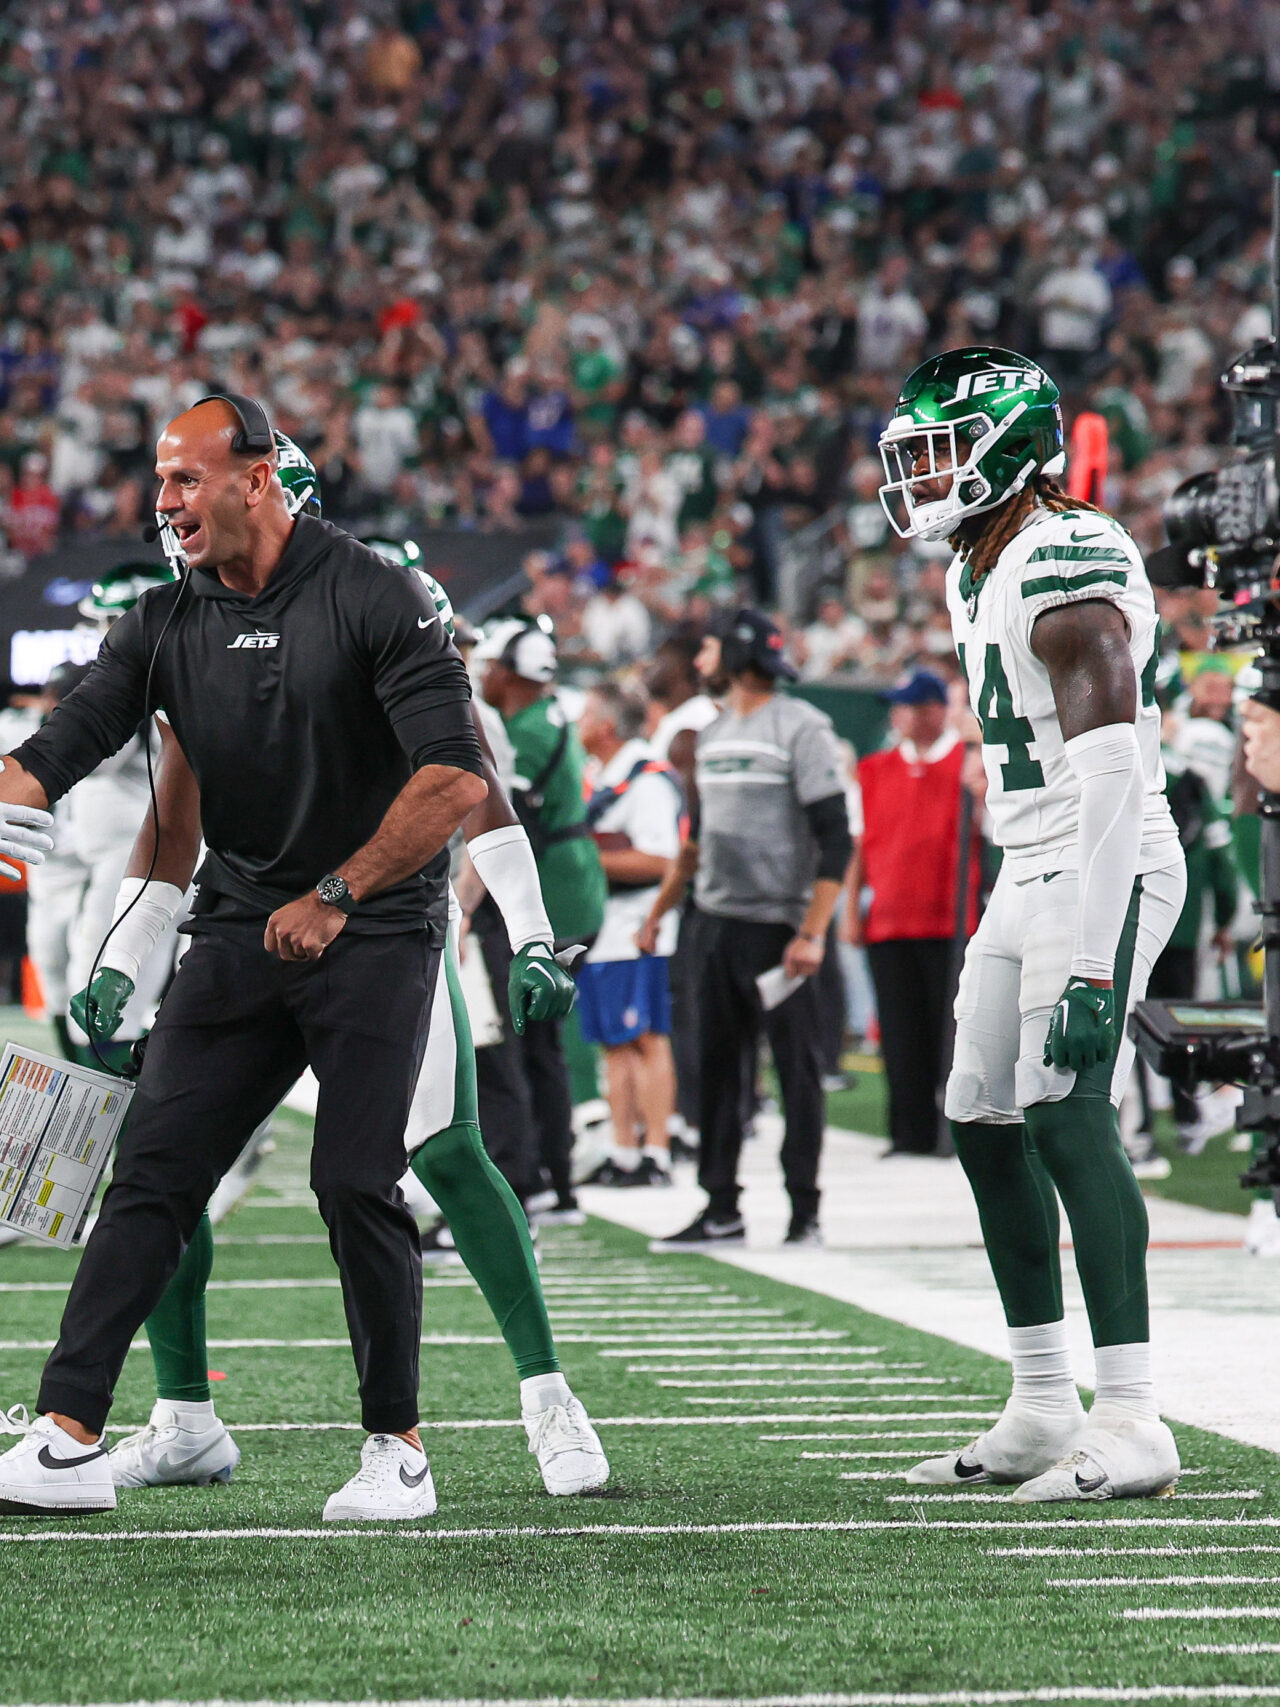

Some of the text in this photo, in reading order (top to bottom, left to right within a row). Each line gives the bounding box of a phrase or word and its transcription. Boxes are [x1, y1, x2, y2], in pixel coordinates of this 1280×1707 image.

[940, 361, 1041, 408] JETS
[227, 629, 280, 649] JETS
[957, 643, 1046, 792] 4
